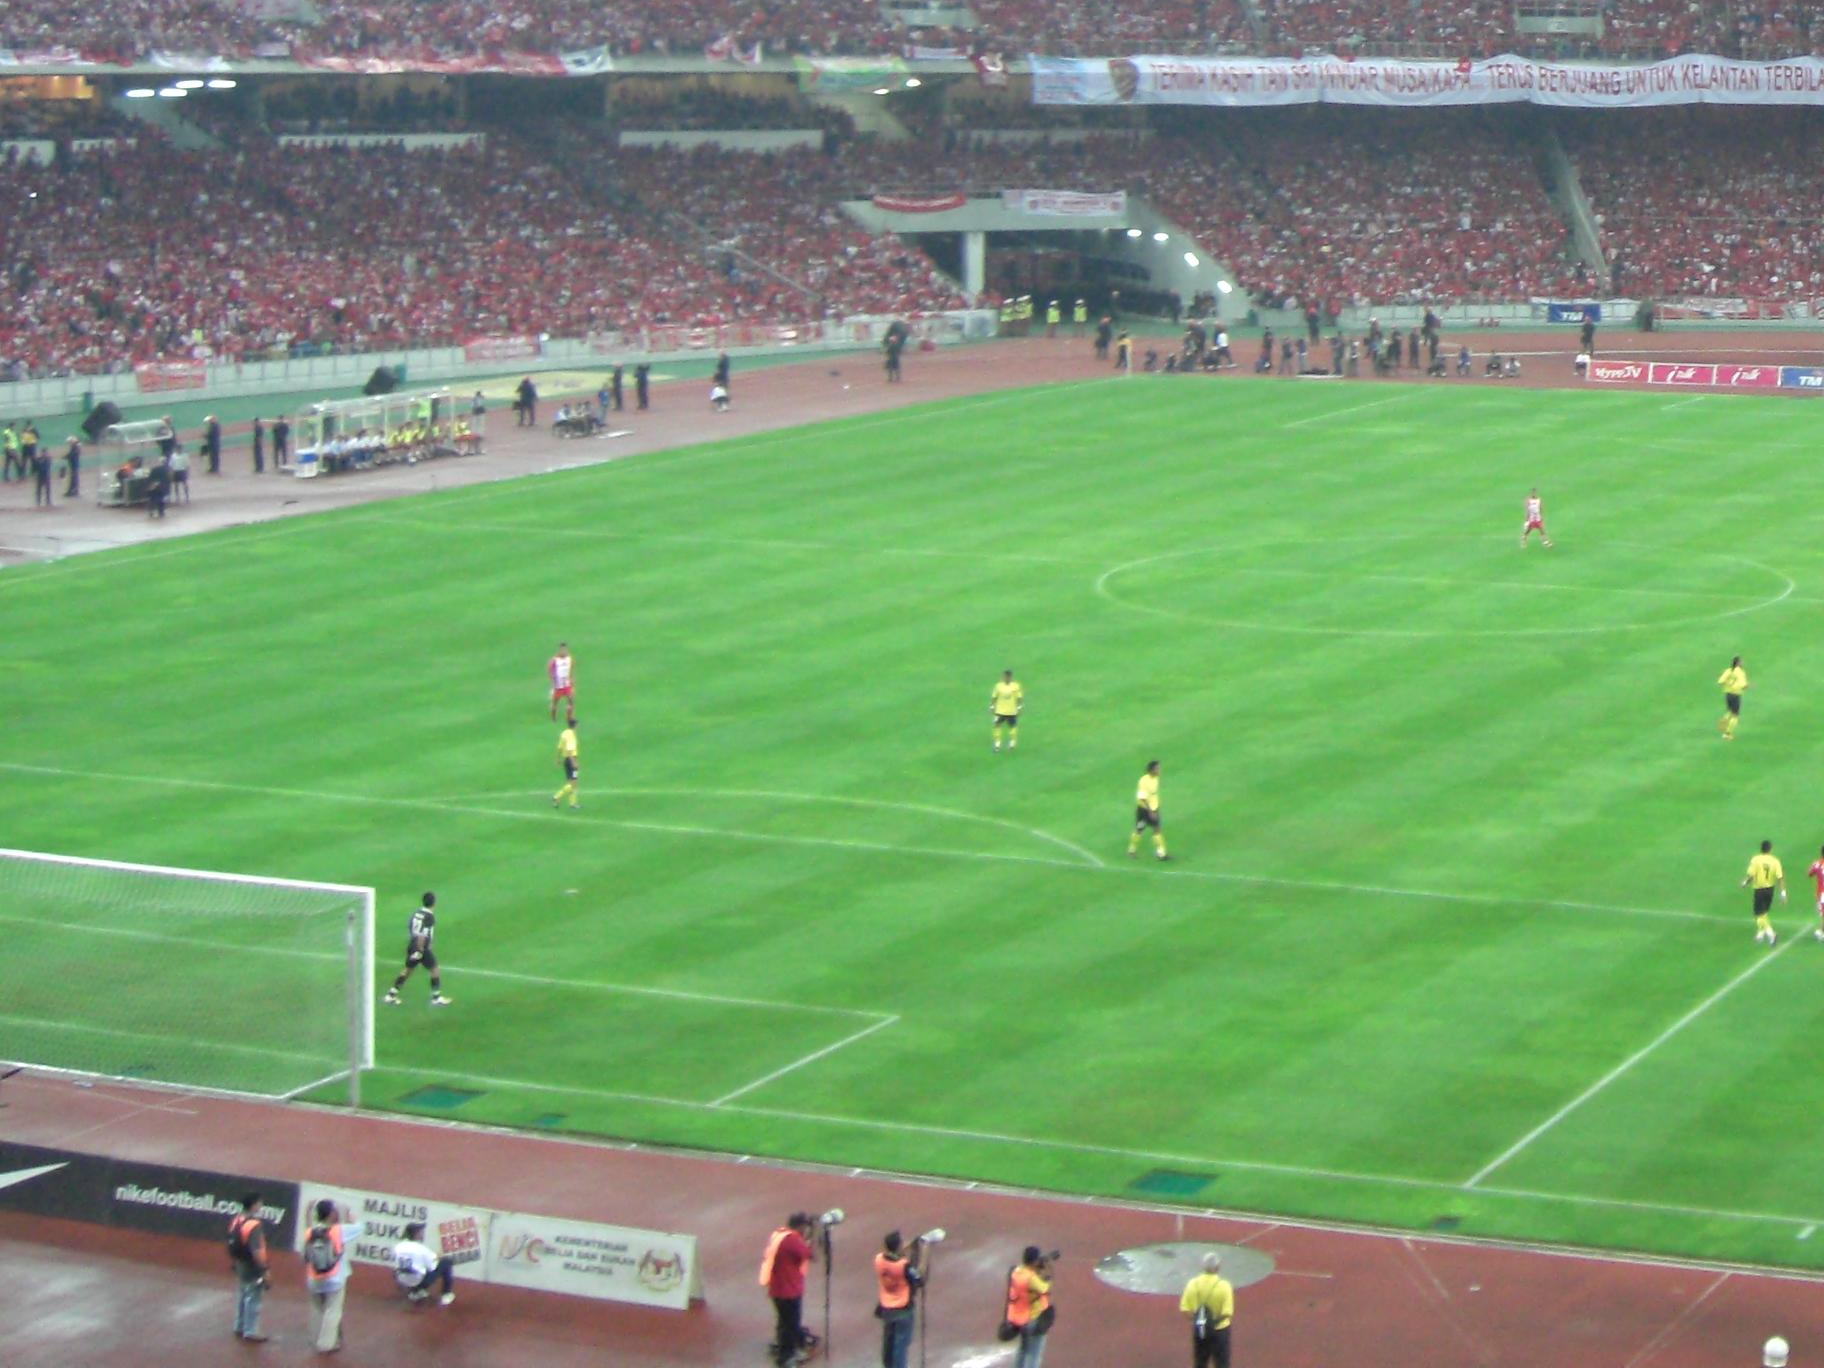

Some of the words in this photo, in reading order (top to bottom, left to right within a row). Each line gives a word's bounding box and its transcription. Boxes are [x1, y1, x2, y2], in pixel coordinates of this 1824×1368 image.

[1487, 63, 1534, 90] TERUS
[1538, 66, 1622, 95] BERJUANG
[1626, 66, 1677, 94] UNTUK
[1680, 63, 1760, 91] KELANTAN
[1561, 311, 1583, 322] TM
[1799, 375, 1823, 387] TM
[115, 1183, 285, 1224] nikefootball.co.my
[364, 1198, 428, 1221] MAJLIS
[365, 1221, 401, 1240] SUK
[355, 1242, 398, 1262] NEG
